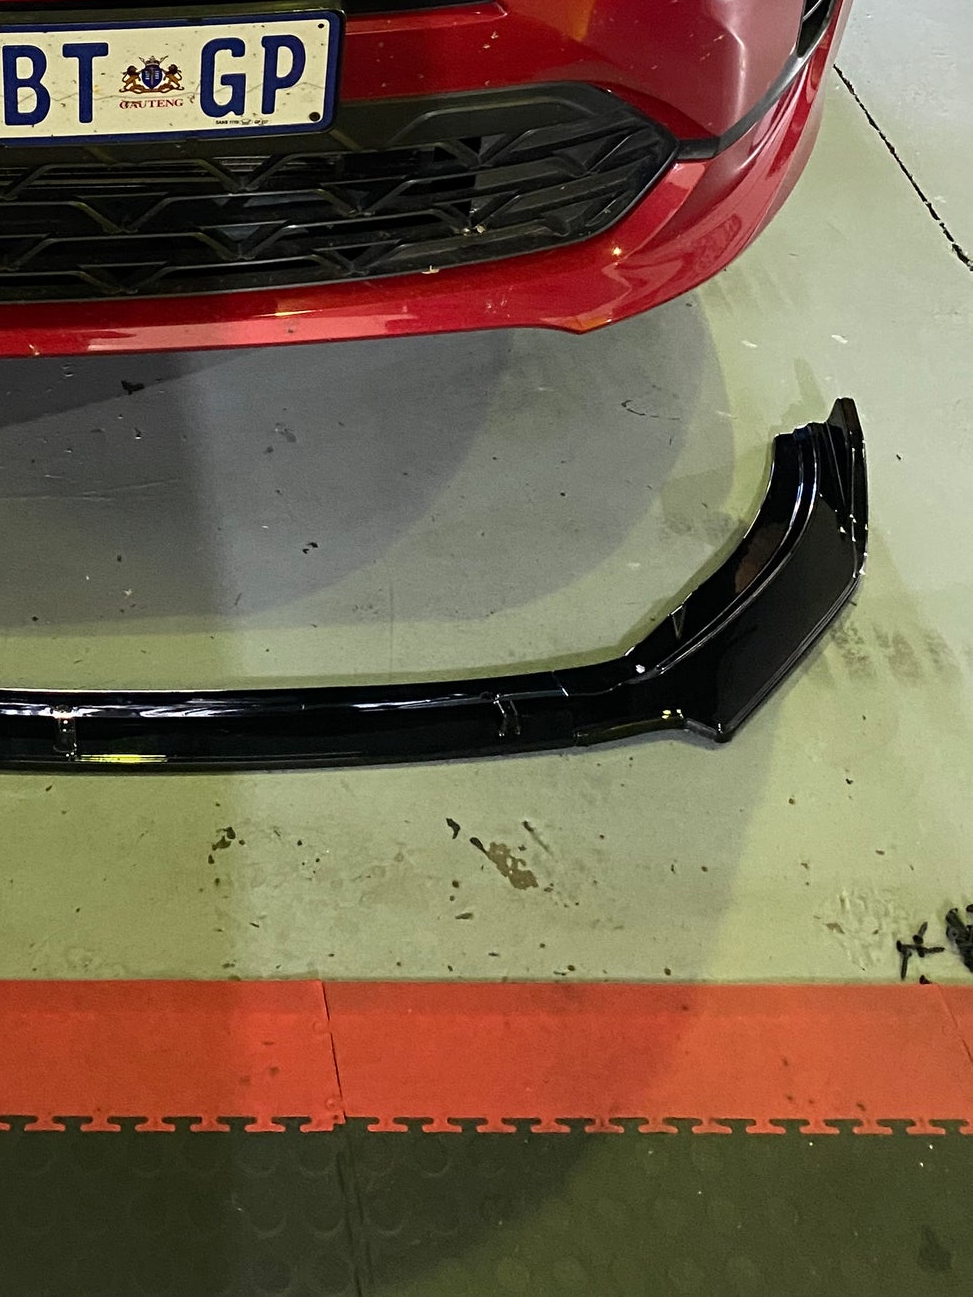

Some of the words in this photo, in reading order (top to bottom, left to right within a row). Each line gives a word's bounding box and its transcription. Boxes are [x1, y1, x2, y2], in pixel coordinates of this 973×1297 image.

[2, 43, 108, 126] BT
[200, 35, 306, 118] GP
[119, 99, 183, 109] GAUTENG
